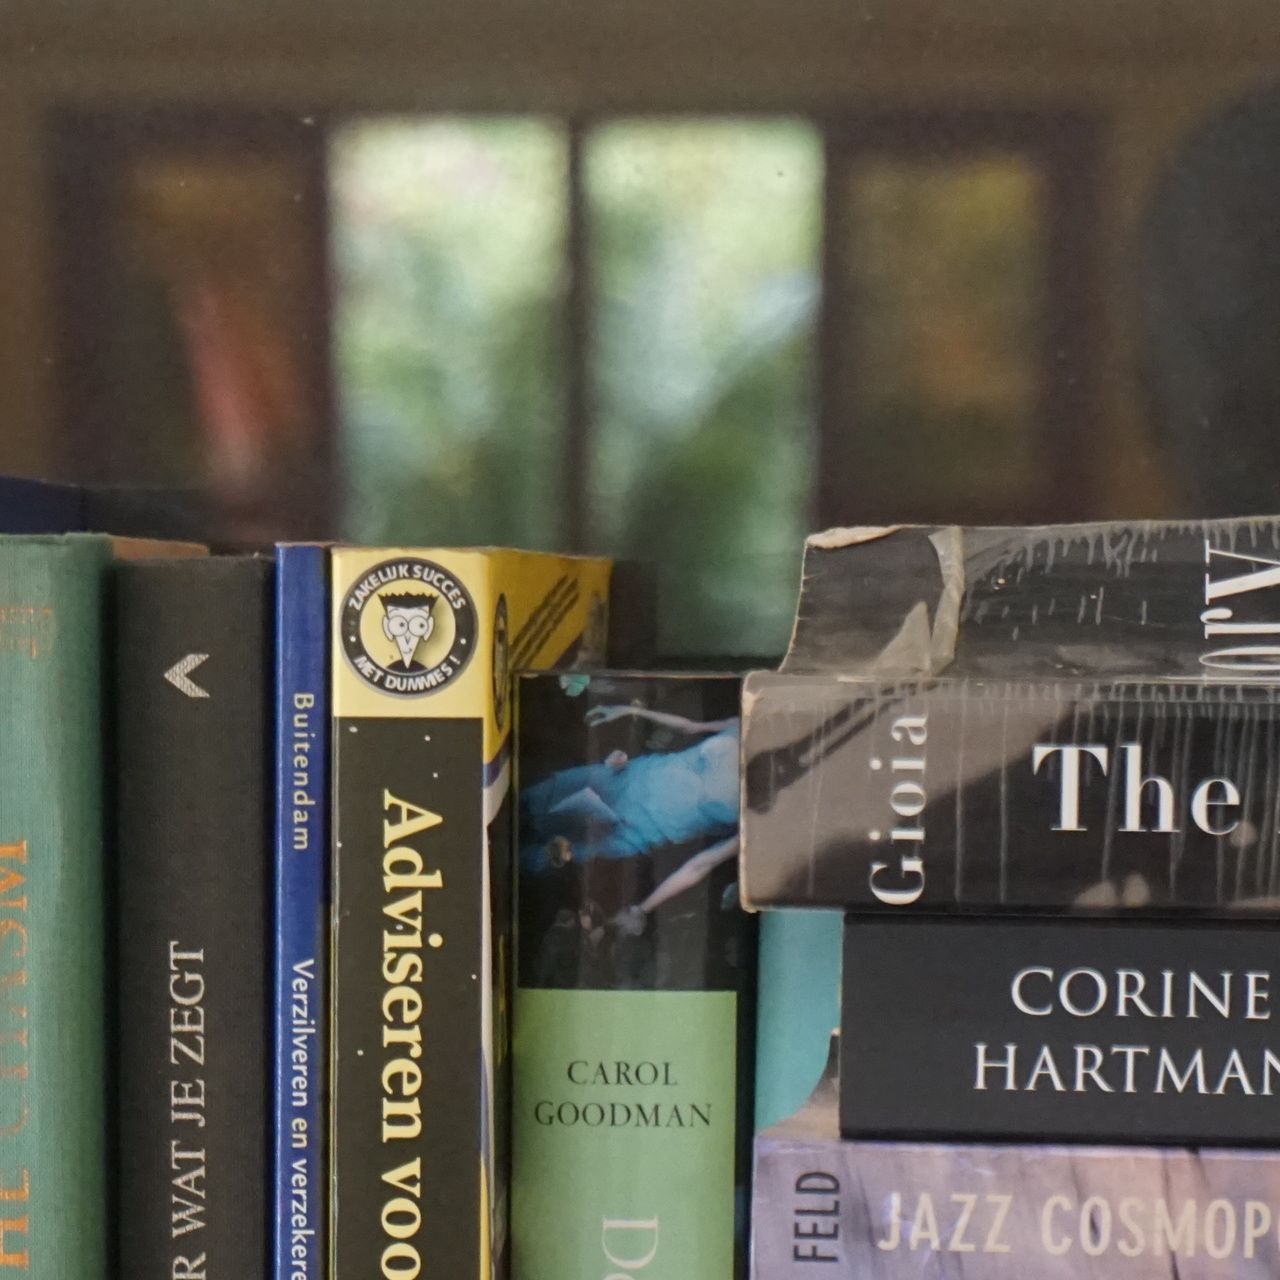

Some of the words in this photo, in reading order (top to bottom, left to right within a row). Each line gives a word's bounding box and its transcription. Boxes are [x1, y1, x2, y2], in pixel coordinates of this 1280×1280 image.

[413, 565, 466, 609] SUCCES
[354, 655, 384, 683] MET
[292, 692, 316, 851] Buitendam
[1032, 744, 1240, 836] The
[870, 715, 928, 906] Gioia
[169, 941, 206, 1066] ZEGT
[381, 789, 443, 1143] Adviseren
[1010, 966, 1273, 1021] CORINE
[291, 958, 316, 1106] Verzilveren
[170, 1079, 206, 1128] JE
[567, 1060, 678, 1086] CAROL
[292, 1119, 308, 1149] en
[534, 1101, 712, 1127] GOODMAN
[170, 1140, 207, 1239] WAT
[793, 1169, 841, 1265] FELD
[876, 1192, 1012, 1255] JAZZ
